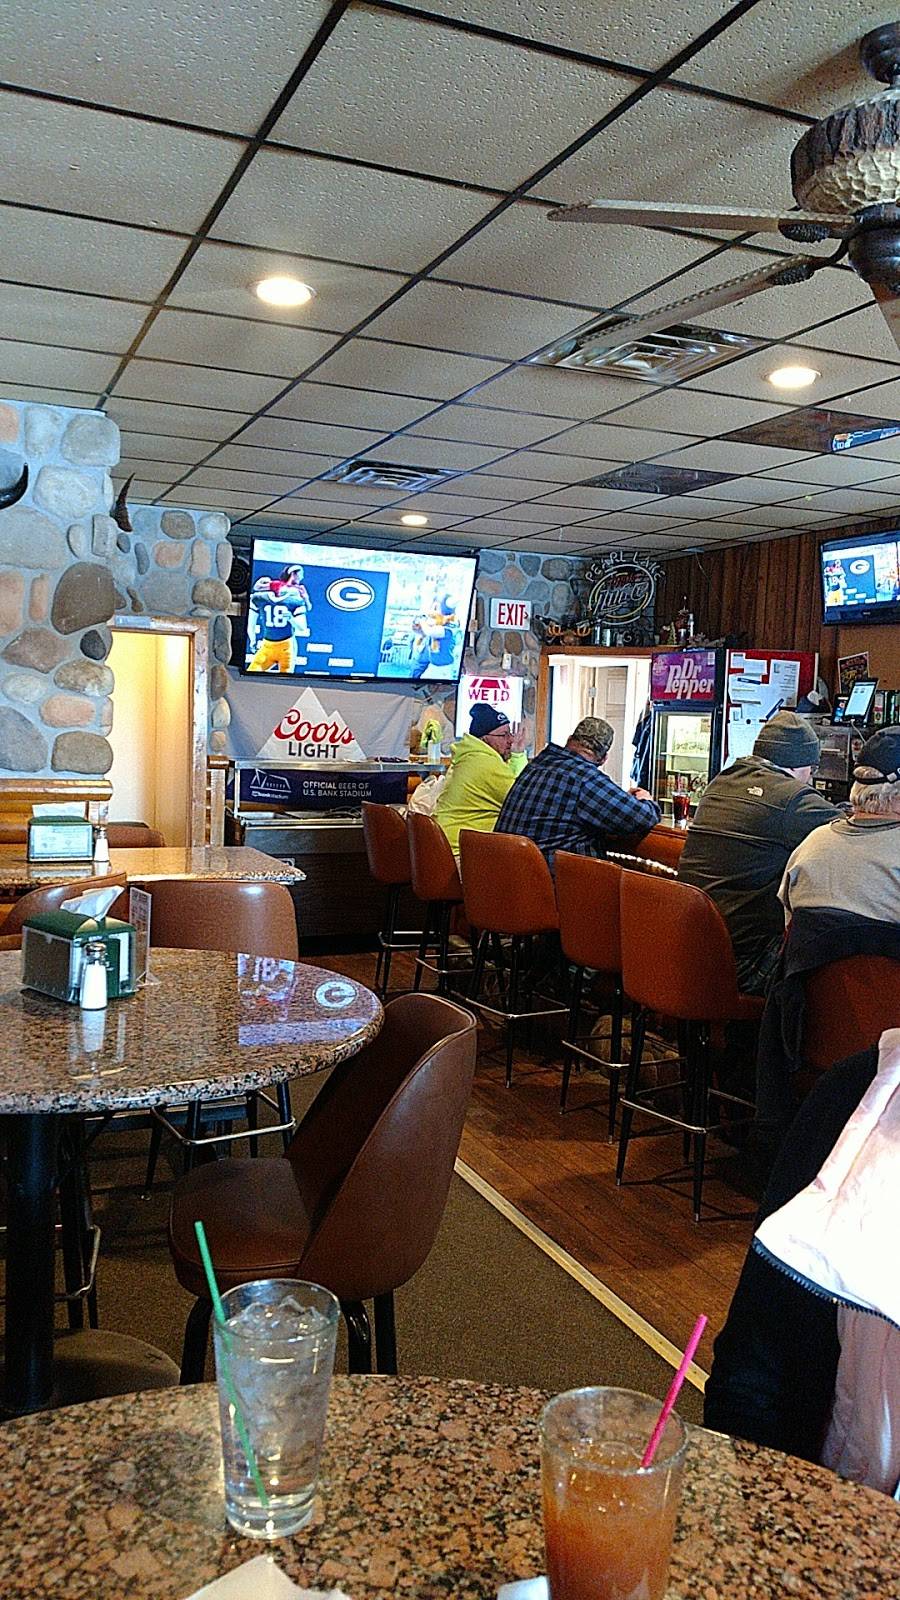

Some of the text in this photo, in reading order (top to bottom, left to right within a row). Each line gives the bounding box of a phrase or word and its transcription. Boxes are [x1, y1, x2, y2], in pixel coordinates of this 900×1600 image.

[585, 550, 666, 582] PEARL LAKE
[264, 605, 289, 629] 18
[498, 602, 526, 627] EXIT
[683, 658, 701, 680] Dr
[665, 665, 714, 699] Pepper
[273, 708, 355, 745] Coors
[288, 741, 340, 759] LIGHT
[302, 781, 370, 790] OFFICIAL BEER OF
[318, 789, 338, 797] BANK
[339, 789, 372, 797] STADIUM
